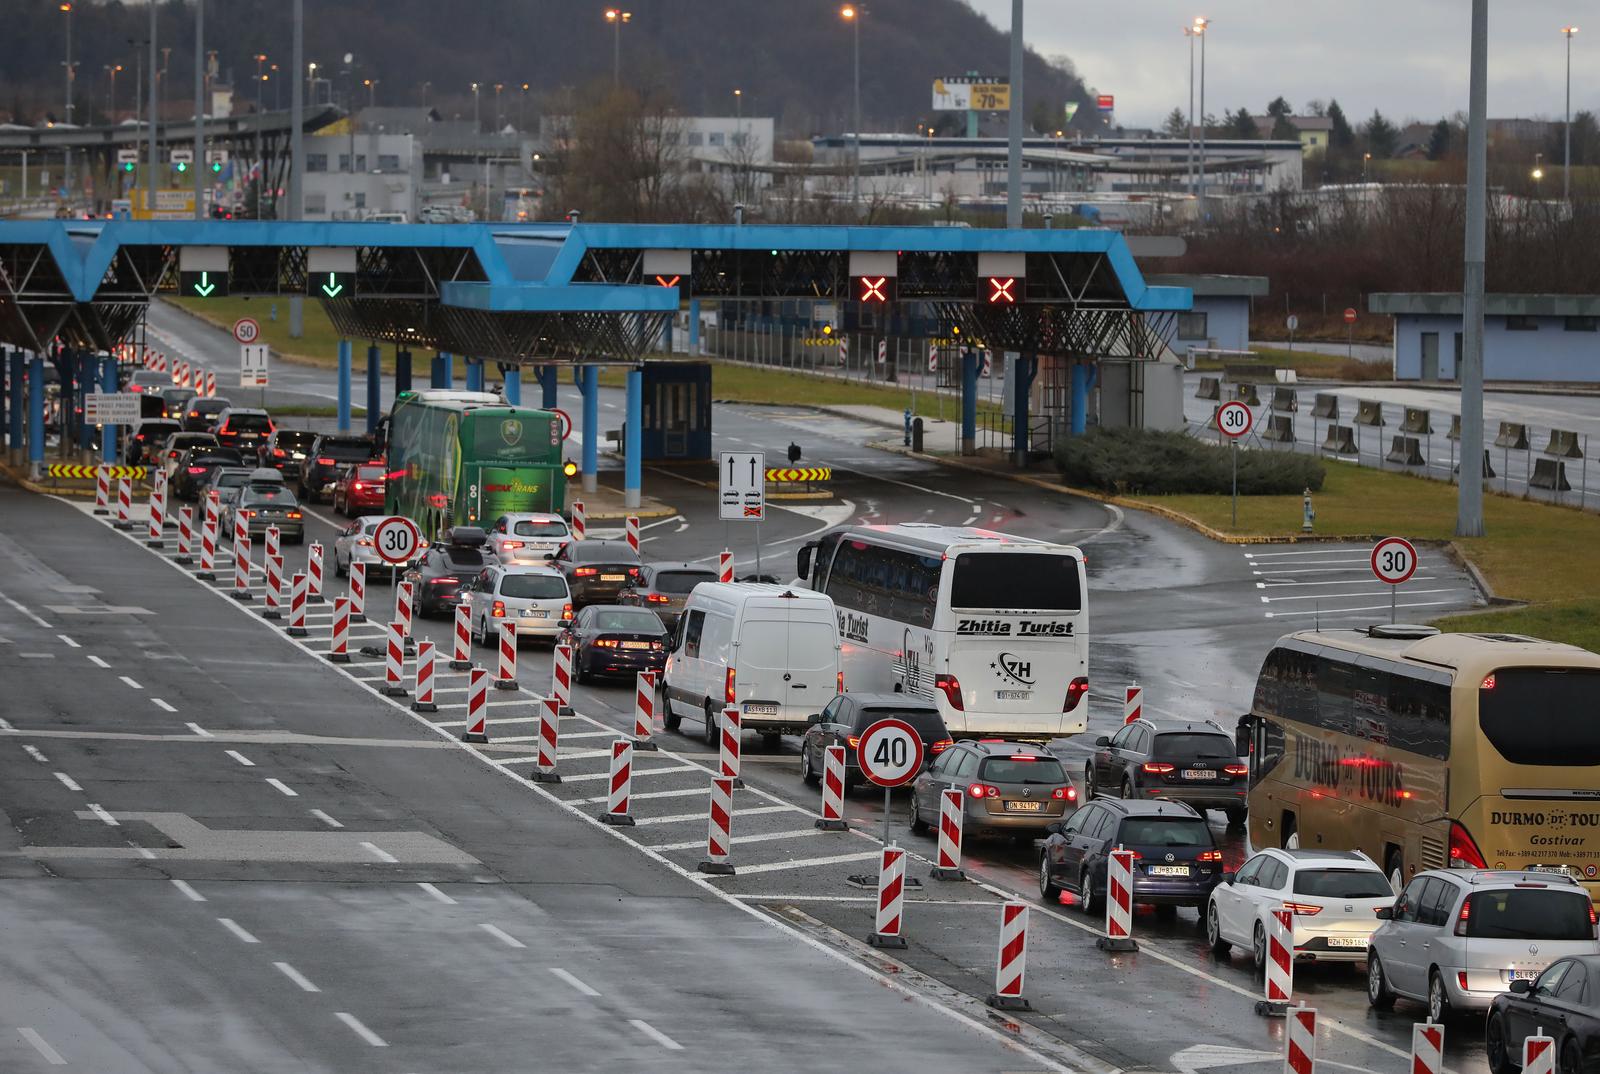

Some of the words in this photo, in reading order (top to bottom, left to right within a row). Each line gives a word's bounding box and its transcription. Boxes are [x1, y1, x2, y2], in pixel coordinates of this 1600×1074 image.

[240, 325, 254, 338] 50
[1225, 410, 1243, 426] 30
[386, 529, 407, 551] 30
[1382, 551, 1405, 572] 30
[848, 614, 869, 637] Turist
[957, 620, 1011, 632] Zhitia
[1019, 621, 1073, 634] Turist
[873, 737, 907, 768] 40
[1295, 734, 1340, 789] DURMO
[1360, 753, 1403, 808] TOURS
[1491, 812, 1544, 825] DURMO
[1551, 816, 1564, 824] DT
[1530, 834, 1585, 846] Gostivar
[1153, 866, 1161, 874] LJ
[1515, 971, 1524, 979] SL
